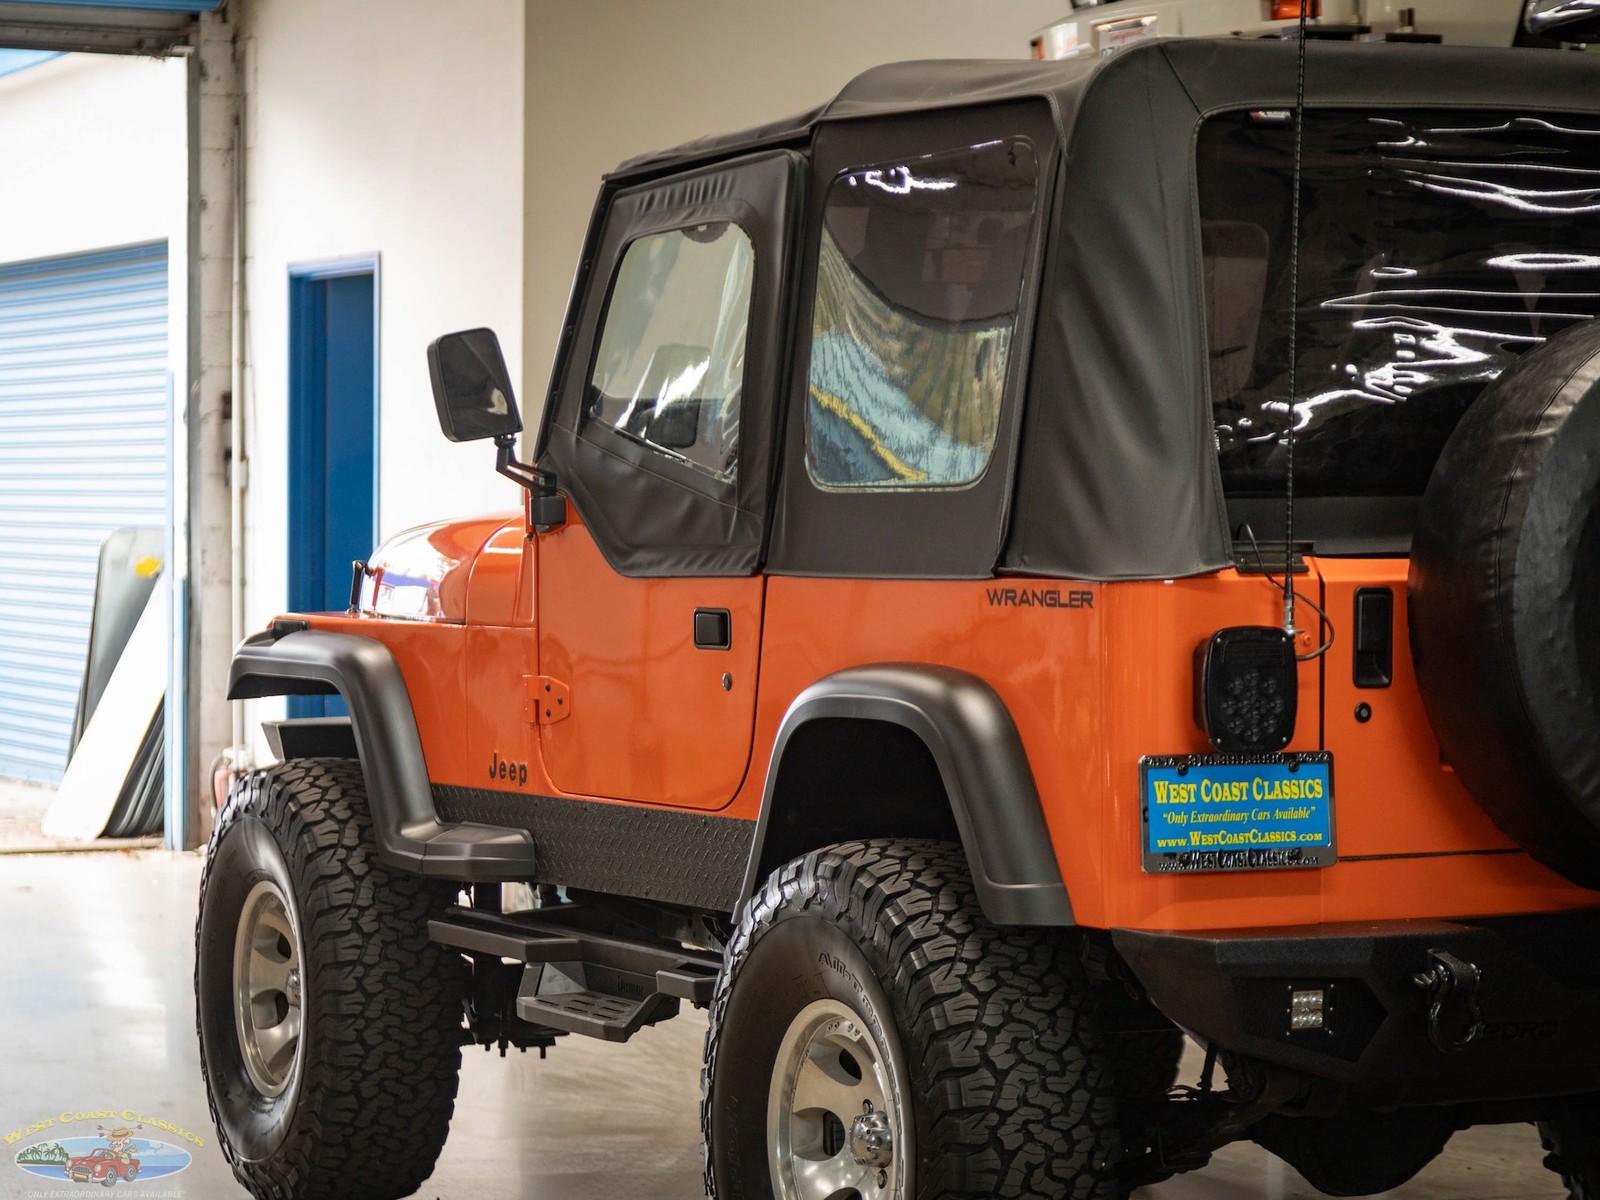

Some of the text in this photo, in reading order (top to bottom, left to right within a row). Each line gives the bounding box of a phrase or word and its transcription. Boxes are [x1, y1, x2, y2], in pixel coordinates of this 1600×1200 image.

[986, 588, 1094, 608] WRANGLER
[489, 752, 528, 787] Jeep
[1154, 777, 1323, 804] WEST COAST CLASSICS
[1190, 809, 1249, 823] Extraordinary
[1251, 808, 1271, 820] Cars
